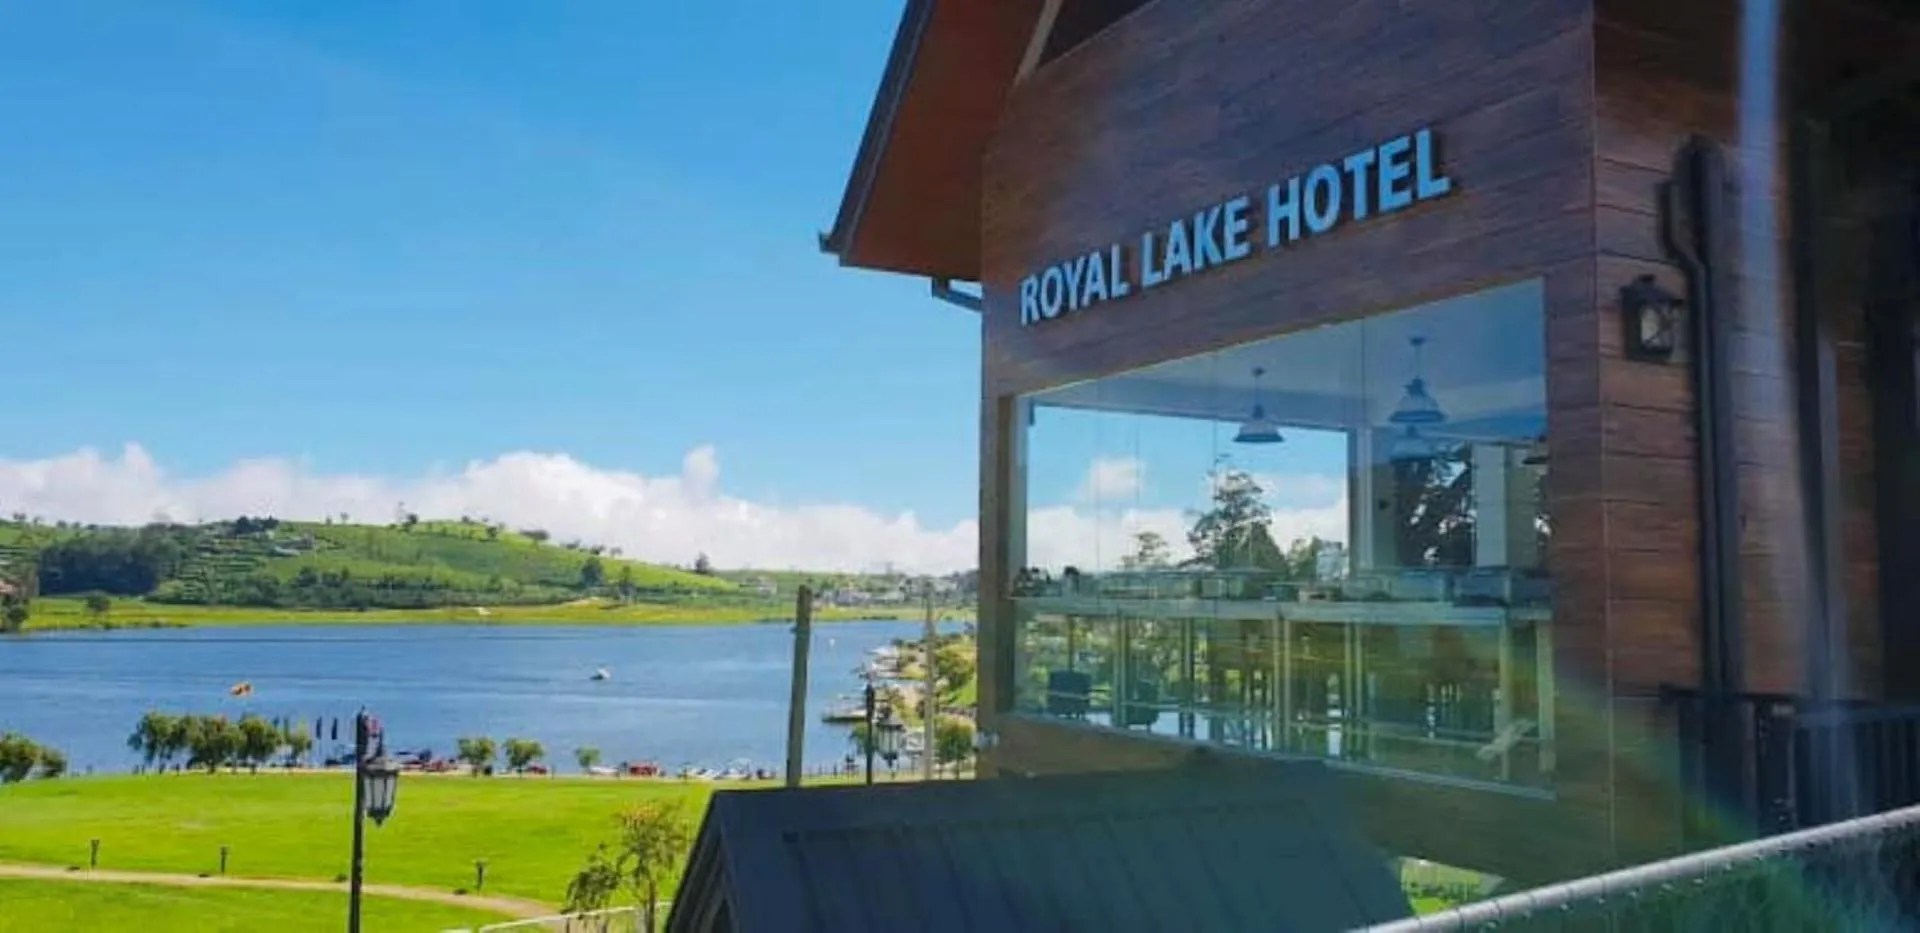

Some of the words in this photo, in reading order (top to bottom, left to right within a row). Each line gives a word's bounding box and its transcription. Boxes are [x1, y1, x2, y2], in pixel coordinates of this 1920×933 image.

[1019, 243, 1131, 326] ROYAL
[1141, 195, 1251, 288] LAKE
[1267, 128, 1451, 247] HOTEL
